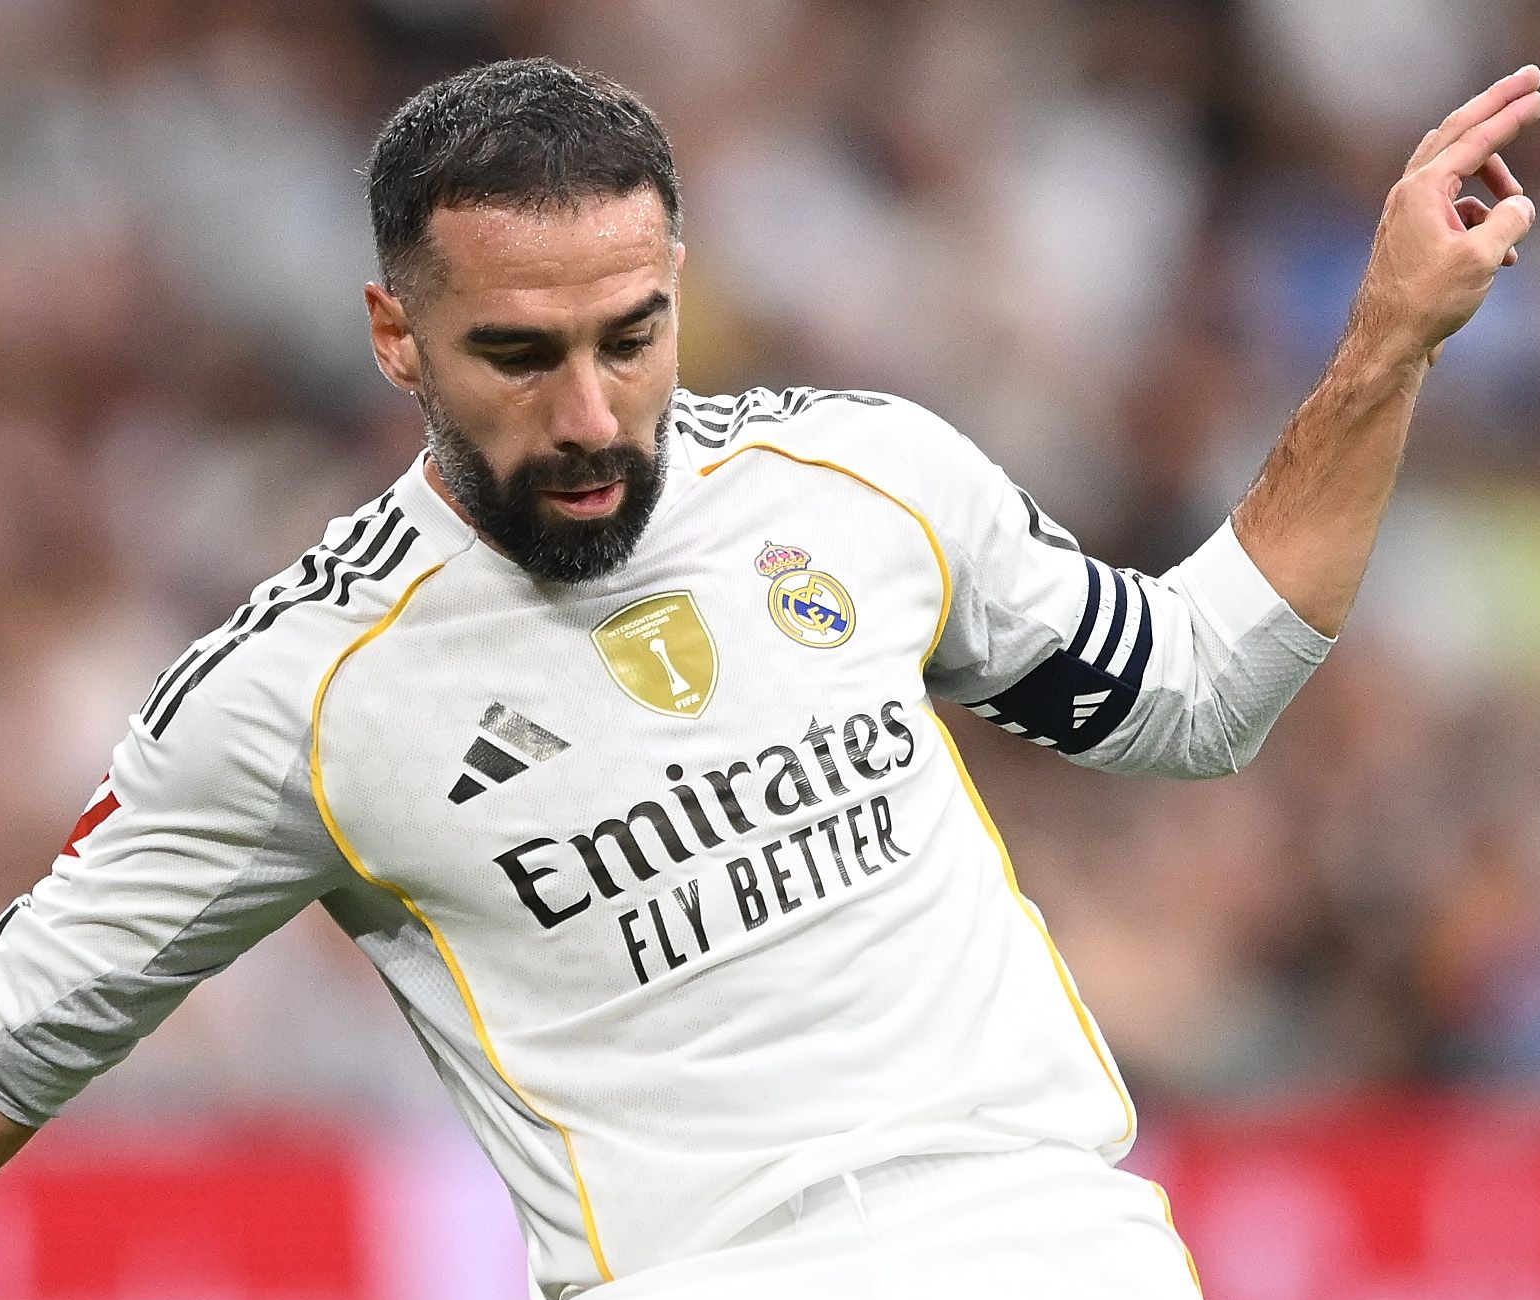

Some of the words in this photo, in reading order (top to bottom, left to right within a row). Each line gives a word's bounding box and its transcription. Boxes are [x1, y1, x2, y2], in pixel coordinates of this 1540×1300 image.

[624, 615, 670, 639] CHAMPIONS
[674, 692, 701, 711] FIFA
[492, 700, 915, 931] Emirates
[617, 878, 711, 985] FLY
[725, 794, 911, 933] BETTER
